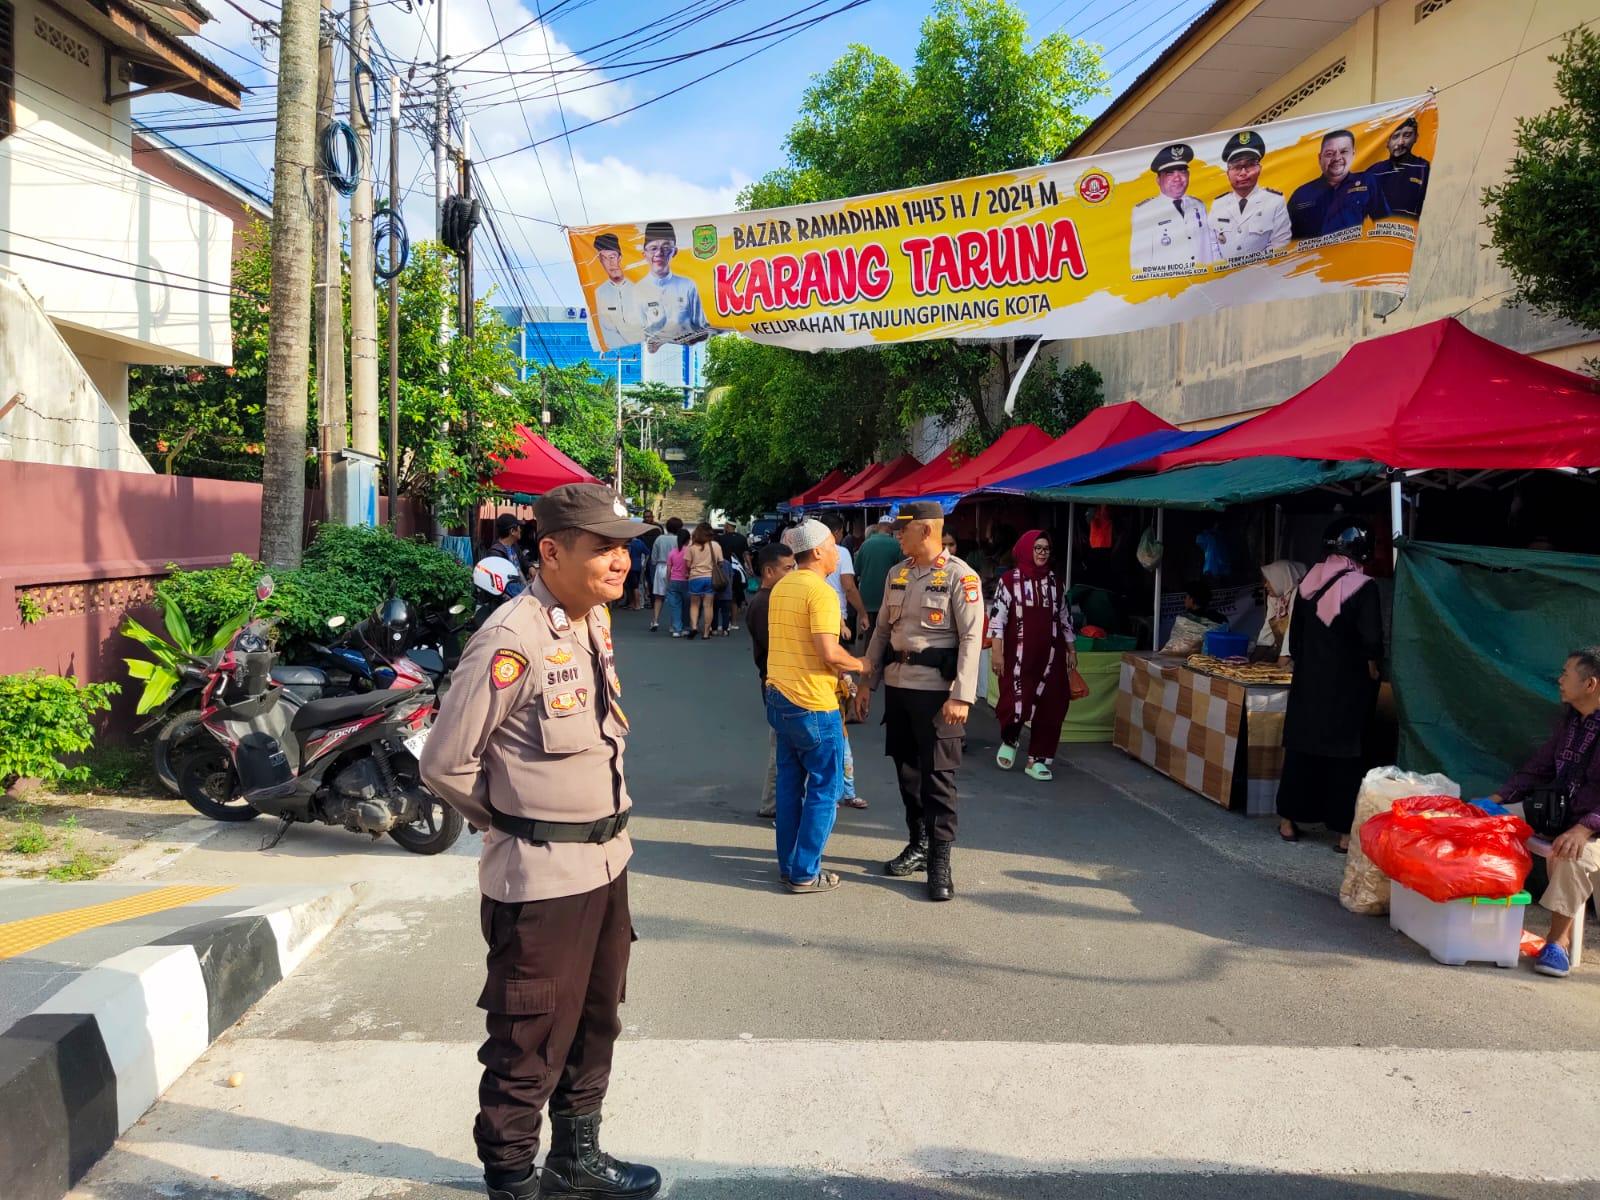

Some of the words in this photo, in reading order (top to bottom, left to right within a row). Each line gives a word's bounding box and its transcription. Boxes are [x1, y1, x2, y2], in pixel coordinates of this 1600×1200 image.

[733, 220, 791, 250] BAZAR
[796, 204, 900, 241] RAMADHAN
[902, 196, 946, 226] 1445
[950, 194, 966, 219] H
[985, 184, 1034, 214] 2024
[1038, 181, 1059, 206] M
[715, 243, 891, 315] KARANG
[902, 219, 1087, 296] TARUNA
[750, 314, 845, 335] KELURAHAN
[849, 299, 999, 331] TANJUNGPINANG
[1005, 294, 1052, 316] KOTA
[925, 585, 948, 593] POLRI
[547, 667, 579, 685] SIGIT
